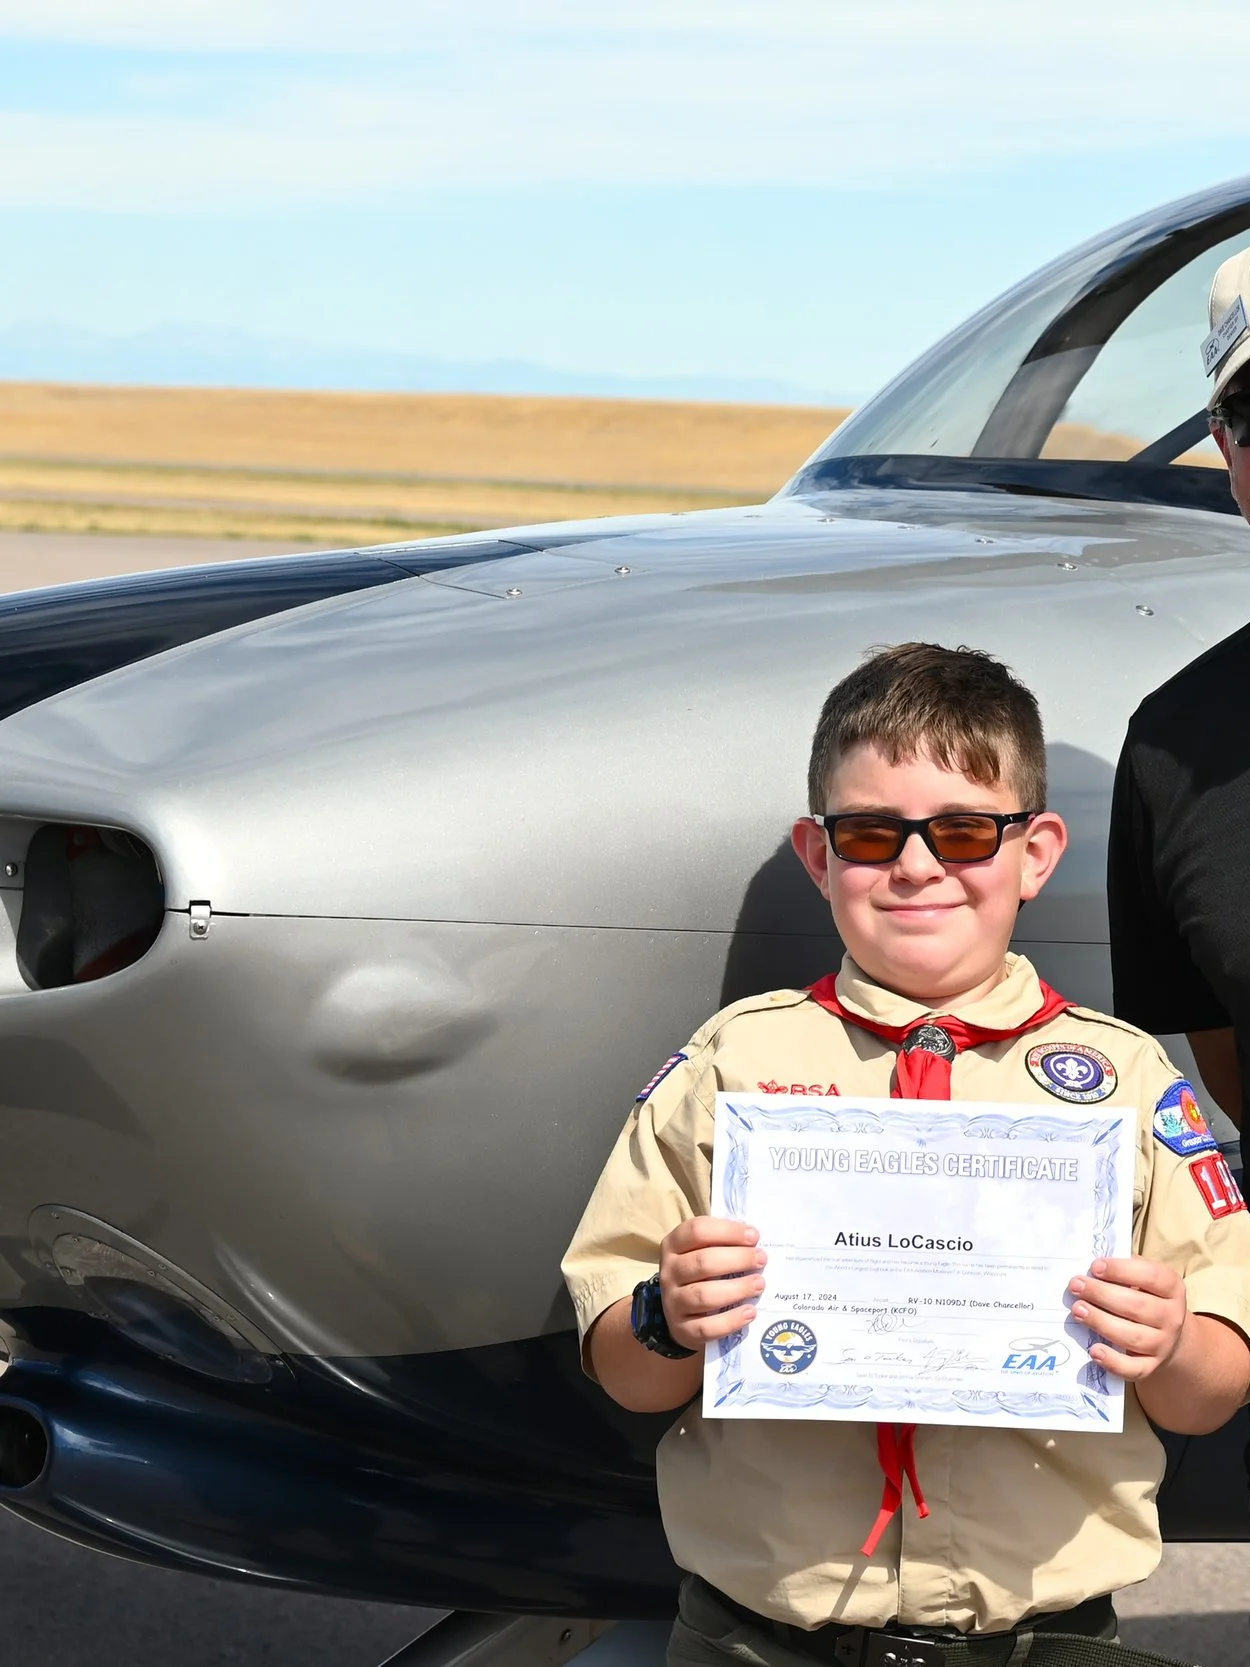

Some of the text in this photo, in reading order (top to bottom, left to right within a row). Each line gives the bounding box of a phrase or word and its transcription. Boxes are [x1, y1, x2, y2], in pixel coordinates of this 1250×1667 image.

[1206, 346, 1219, 366] EAA
[1056, 1088, 1081, 1100] SINCE
[770, 1147, 1078, 1182] YOUNG EAGLES CERTIFICATE
[834, 1232, 974, 1251] Atius LoCascio
[774, 1293, 799, 1302] August
[908, 1297, 1034, 1310] RV-10 N109DJ (Dave Chancellor)
[792, 1304, 824, 1312] Colorado
[828, 1304, 839, 1312] Air
[850, 1306, 888, 1314] Spaceport
[890, 1307, 917, 1316] (KCFO)
[765, 1322, 814, 1342] YOUNG EAGLES
[1002, 1354, 1056, 1370] EAA
